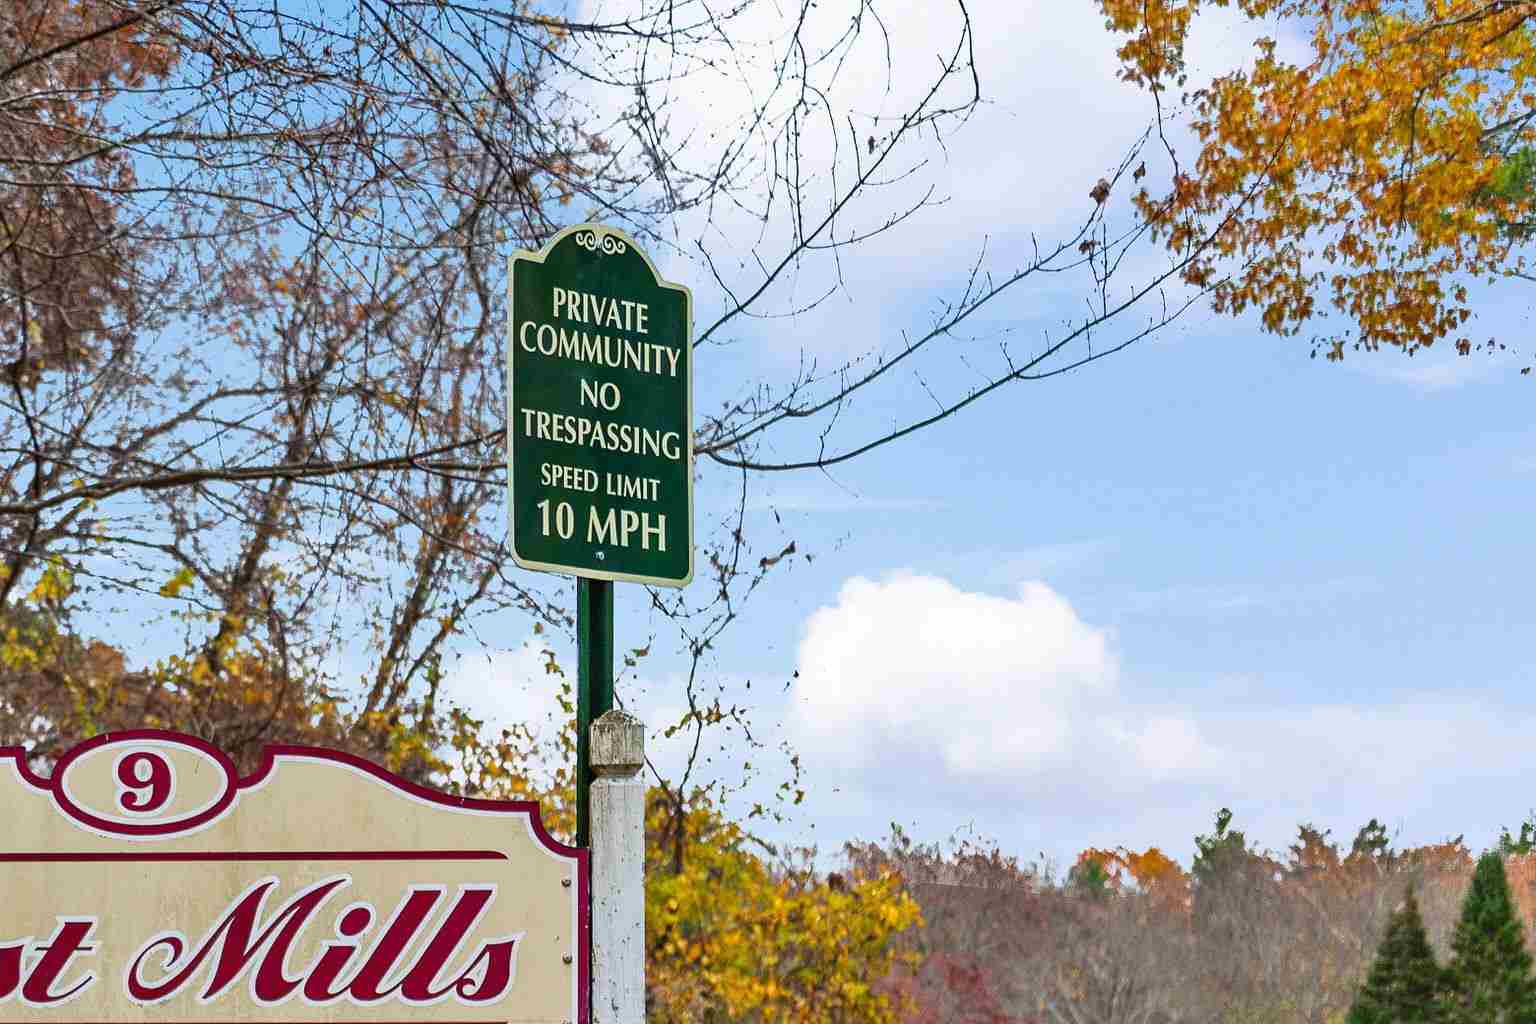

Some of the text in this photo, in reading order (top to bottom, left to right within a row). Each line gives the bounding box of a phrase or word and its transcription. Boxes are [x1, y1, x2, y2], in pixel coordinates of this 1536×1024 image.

[552, 287, 649, 334] PRIVATE
[520, 320, 681, 377] COMMUNITY
[580, 378, 621, 411] NO
[521, 408, 681, 460] TRESPASSING
[541, 462, 661, 502] SPEED LIMIT
[536, 499, 666, 553] 10 MPH
[117, 751, 172, 812] 9
[127, 877, 516, 1003] Mills
